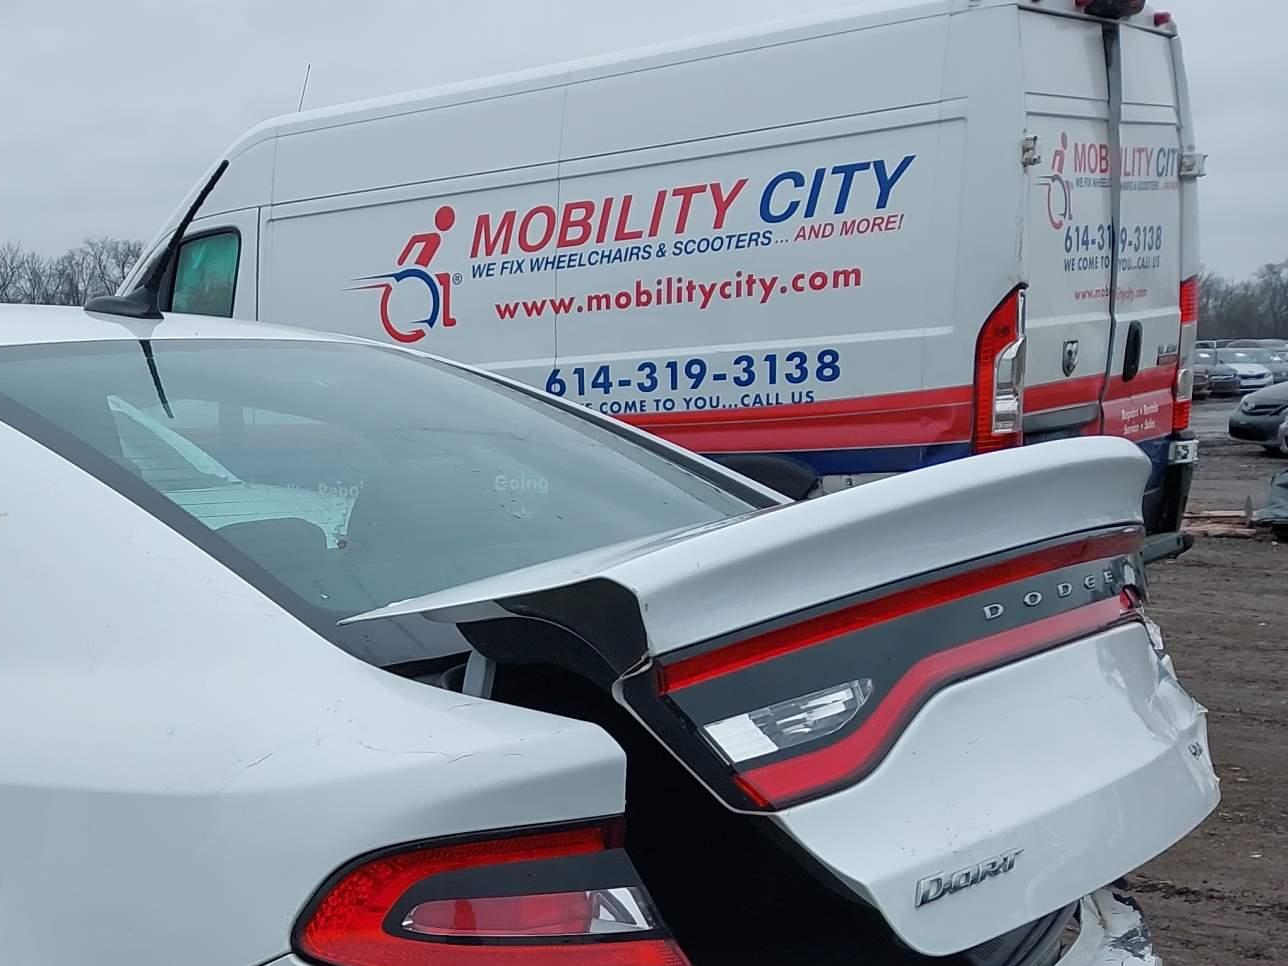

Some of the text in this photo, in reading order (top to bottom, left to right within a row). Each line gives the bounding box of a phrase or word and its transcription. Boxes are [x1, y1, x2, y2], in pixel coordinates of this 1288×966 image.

[1156, 147, 1179, 177] CIT
[470, 155, 917, 258] MOBILITY CITY
[472, 263, 495, 279] WE
[500, 259, 526, 276] FIX
[530, 245, 652, 273] WHEELCHAIRS
[656, 243, 666, 257] &
[839, 214, 905, 237] MORE!
[1064, 258, 1075, 272] WE
[1078, 256, 1098, 271] COME
[1101, 256, 1110, 269] TO
[495, 268, 862, 320] www.mobilitycity.com
[546, 349, 840, 397] 614-319-3138
[599, 400, 647, 414] COME
[653, 398, 675, 412] TO
[791, 390, 815, 404] US
[983, 569, 1114, 620] DODGE
